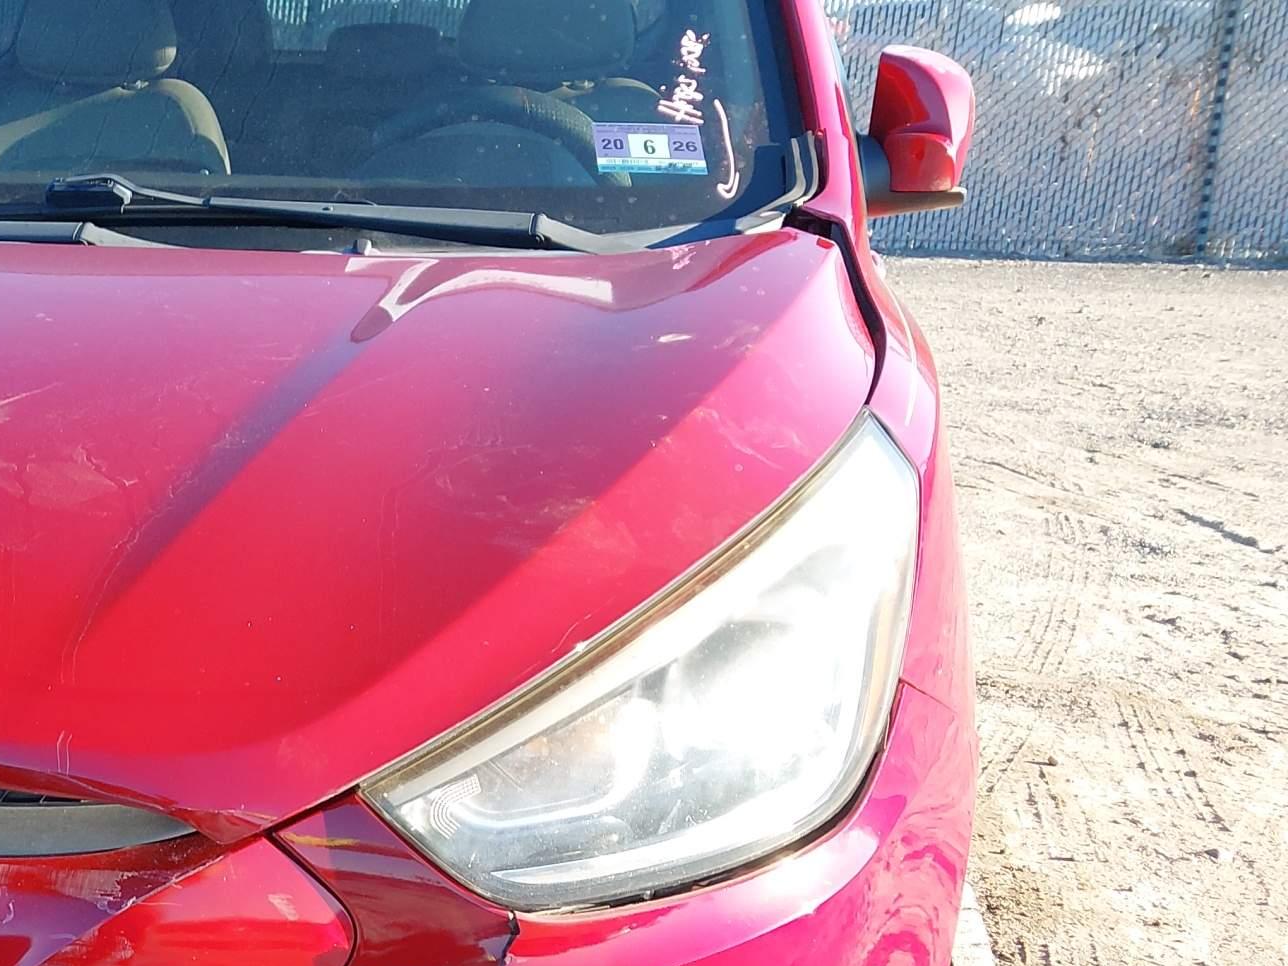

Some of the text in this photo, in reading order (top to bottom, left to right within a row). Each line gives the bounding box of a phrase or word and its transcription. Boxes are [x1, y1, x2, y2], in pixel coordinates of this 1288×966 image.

[601, 138, 698, 154] 20 6 26
